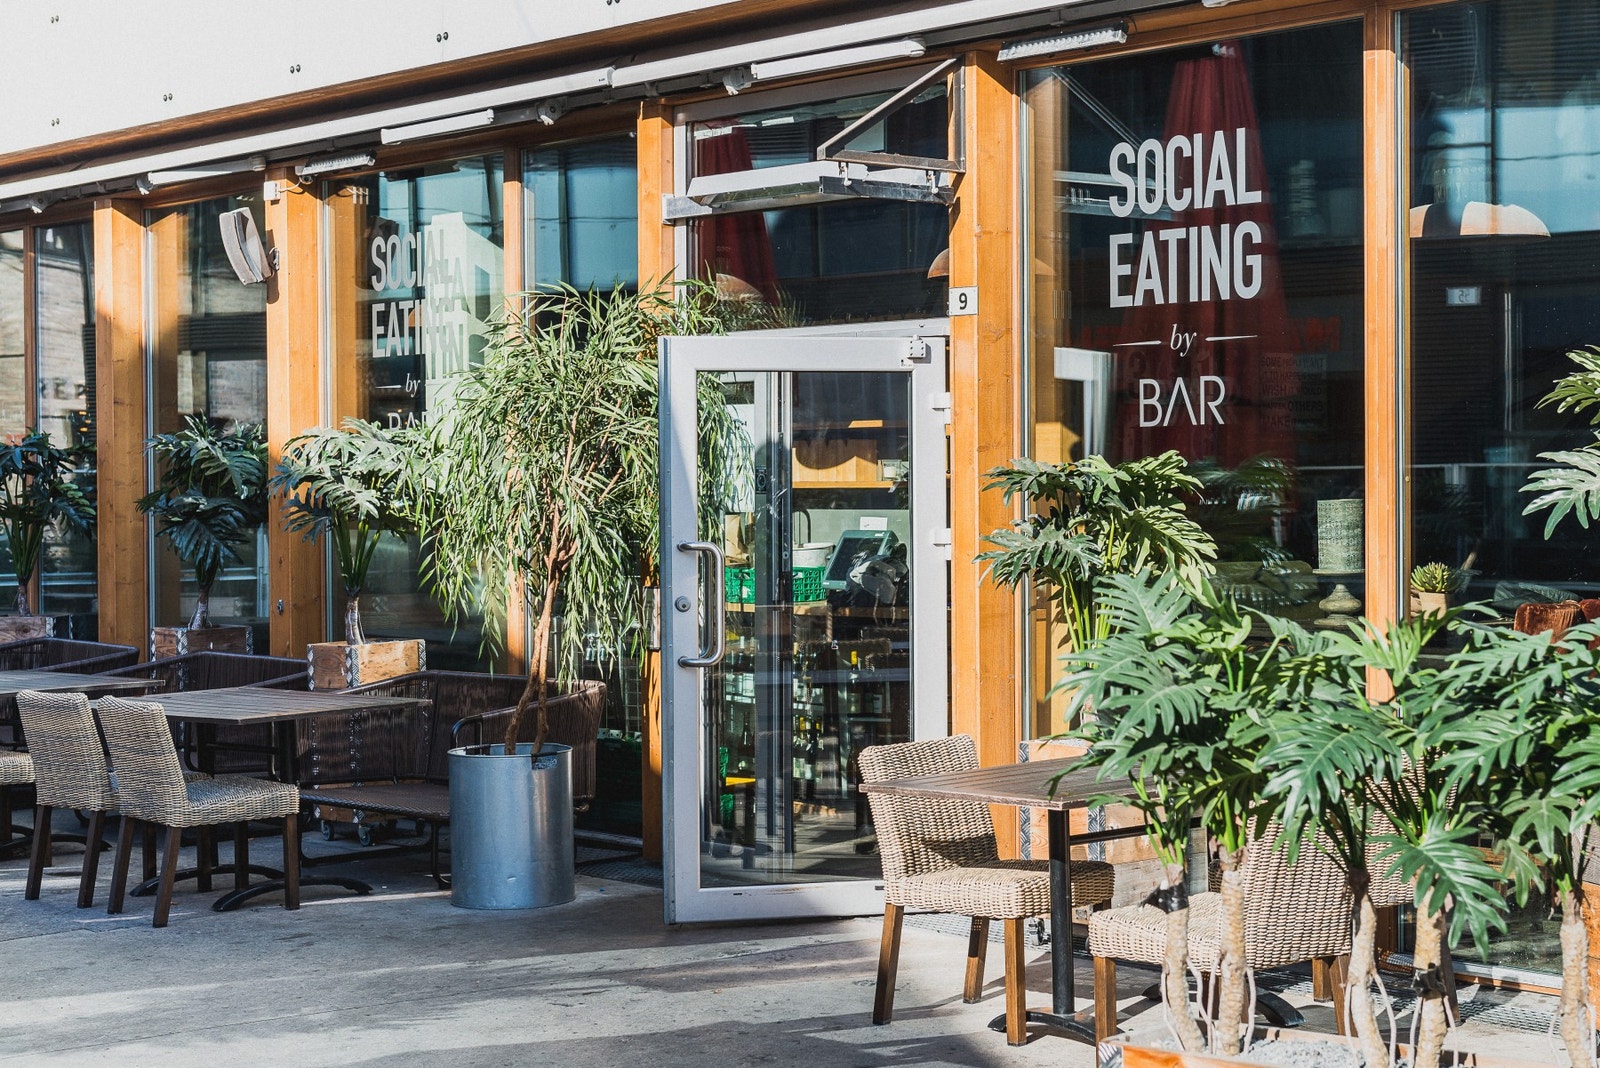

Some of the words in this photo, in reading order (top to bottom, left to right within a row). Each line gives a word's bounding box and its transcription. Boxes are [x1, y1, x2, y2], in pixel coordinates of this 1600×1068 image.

[1108, 127, 1262, 218] SOCIAL
[1109, 220, 1262, 309] EATING
[959, 292, 968, 310] 9
[1169, 323, 1198, 358] by
[405, 372, 420, 398] by
[1139, 375, 1226, 428] BAR
